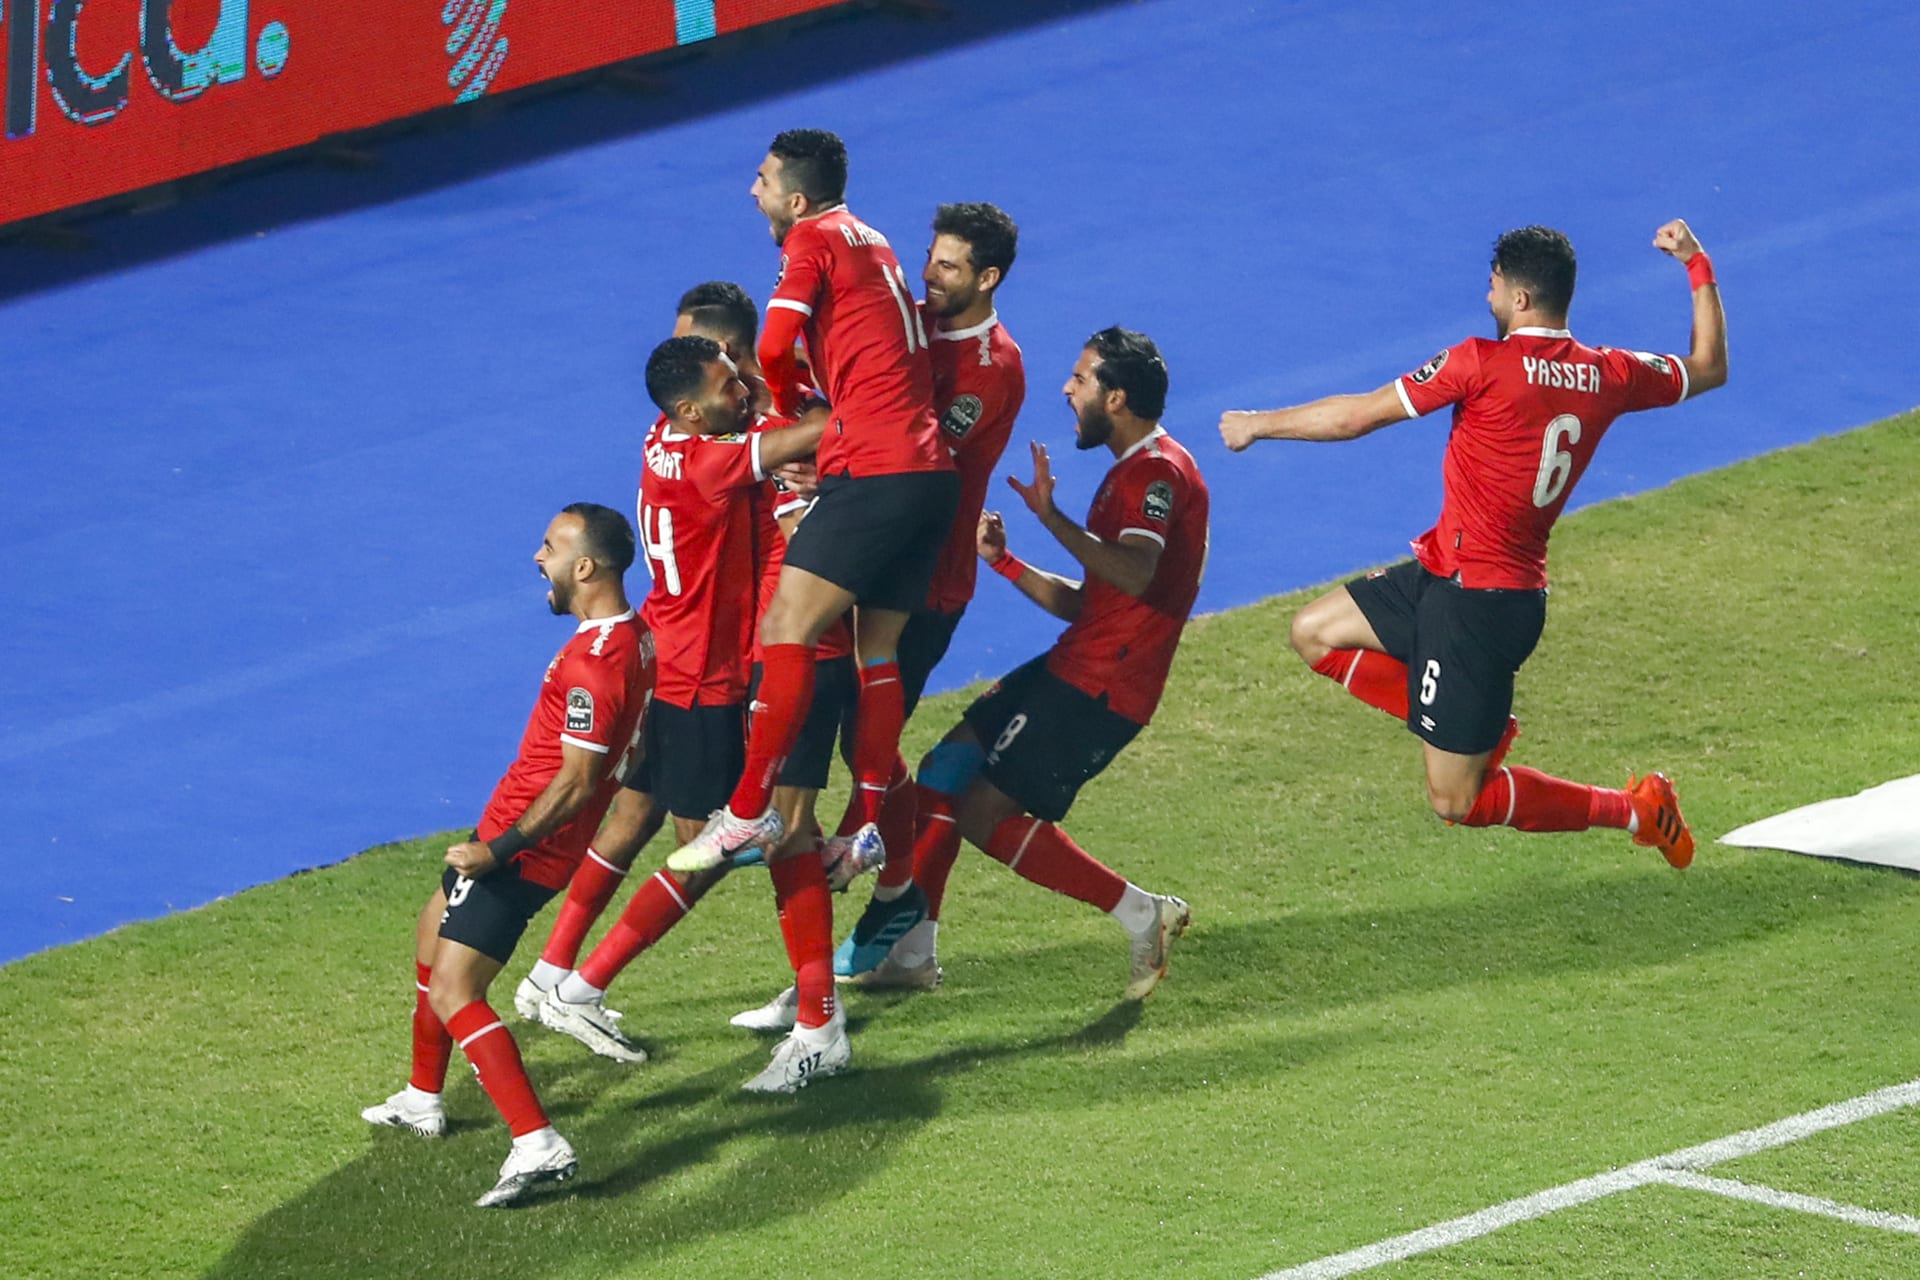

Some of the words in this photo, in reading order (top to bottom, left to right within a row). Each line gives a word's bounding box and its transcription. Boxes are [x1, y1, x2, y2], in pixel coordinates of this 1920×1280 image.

[1522, 355, 1600, 394] YASSER
[1532, 414, 1582, 508] 6
[1420, 659, 1441, 705] 6
[994, 713, 1028, 751] 8
